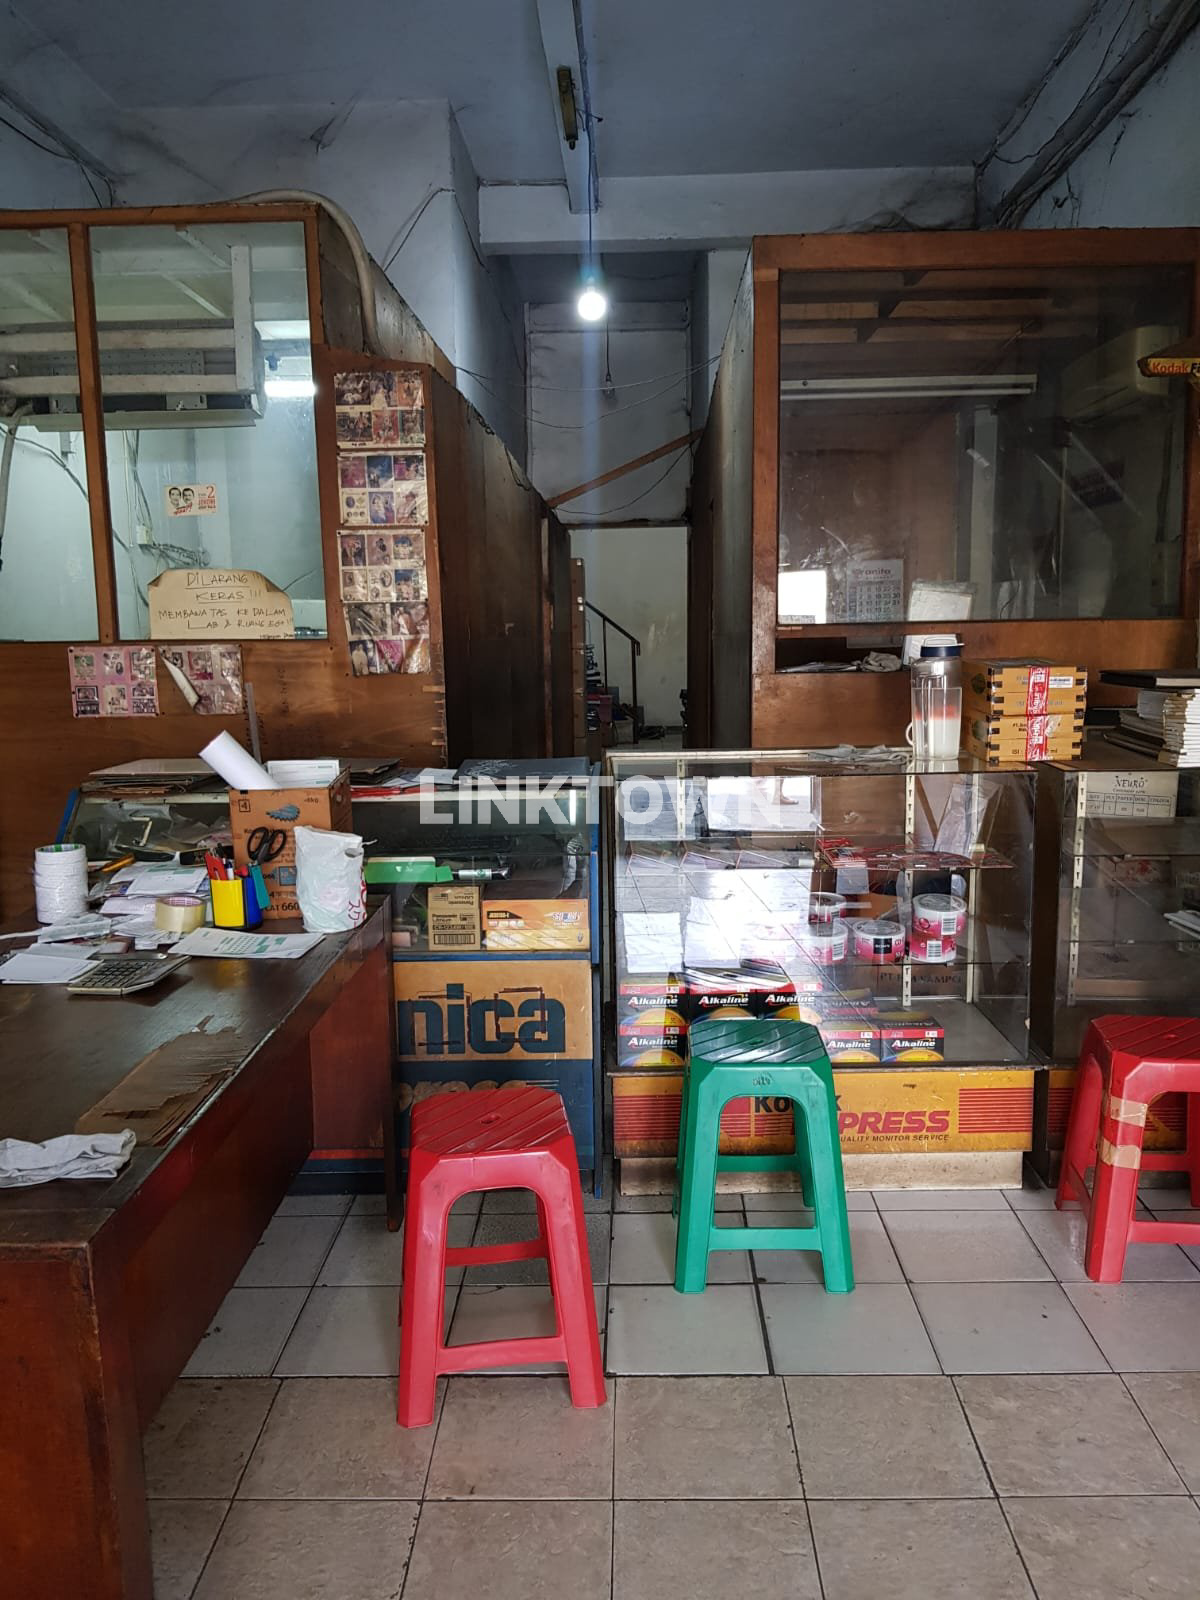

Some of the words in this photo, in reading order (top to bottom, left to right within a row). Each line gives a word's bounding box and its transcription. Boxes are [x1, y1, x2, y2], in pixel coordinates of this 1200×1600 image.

[1151, 361, 1188, 374] Kodak
[206, 486, 215, 499] 2
[196, 591, 244, 601] KERAS
[253, 607, 286, 617] DALAM
[281, 903, 300, 912] 660
[628, 994, 678, 1005] Alkaline
[699, 995, 749, 1005] Alkaline
[765, 993, 815, 1004] Alkaline
[627, 1036, 678, 1047] Alkaline
[827, 1040, 872, 1049] Alkaline
[891, 1039, 936, 1048] Alkaline
[838, 1111, 951, 1134] PRESS
[840, 1134, 870, 1143] UALITY
[872, 1134, 910, 1142] MONITOR
[912, 1134, 950, 1142] SERVICE
